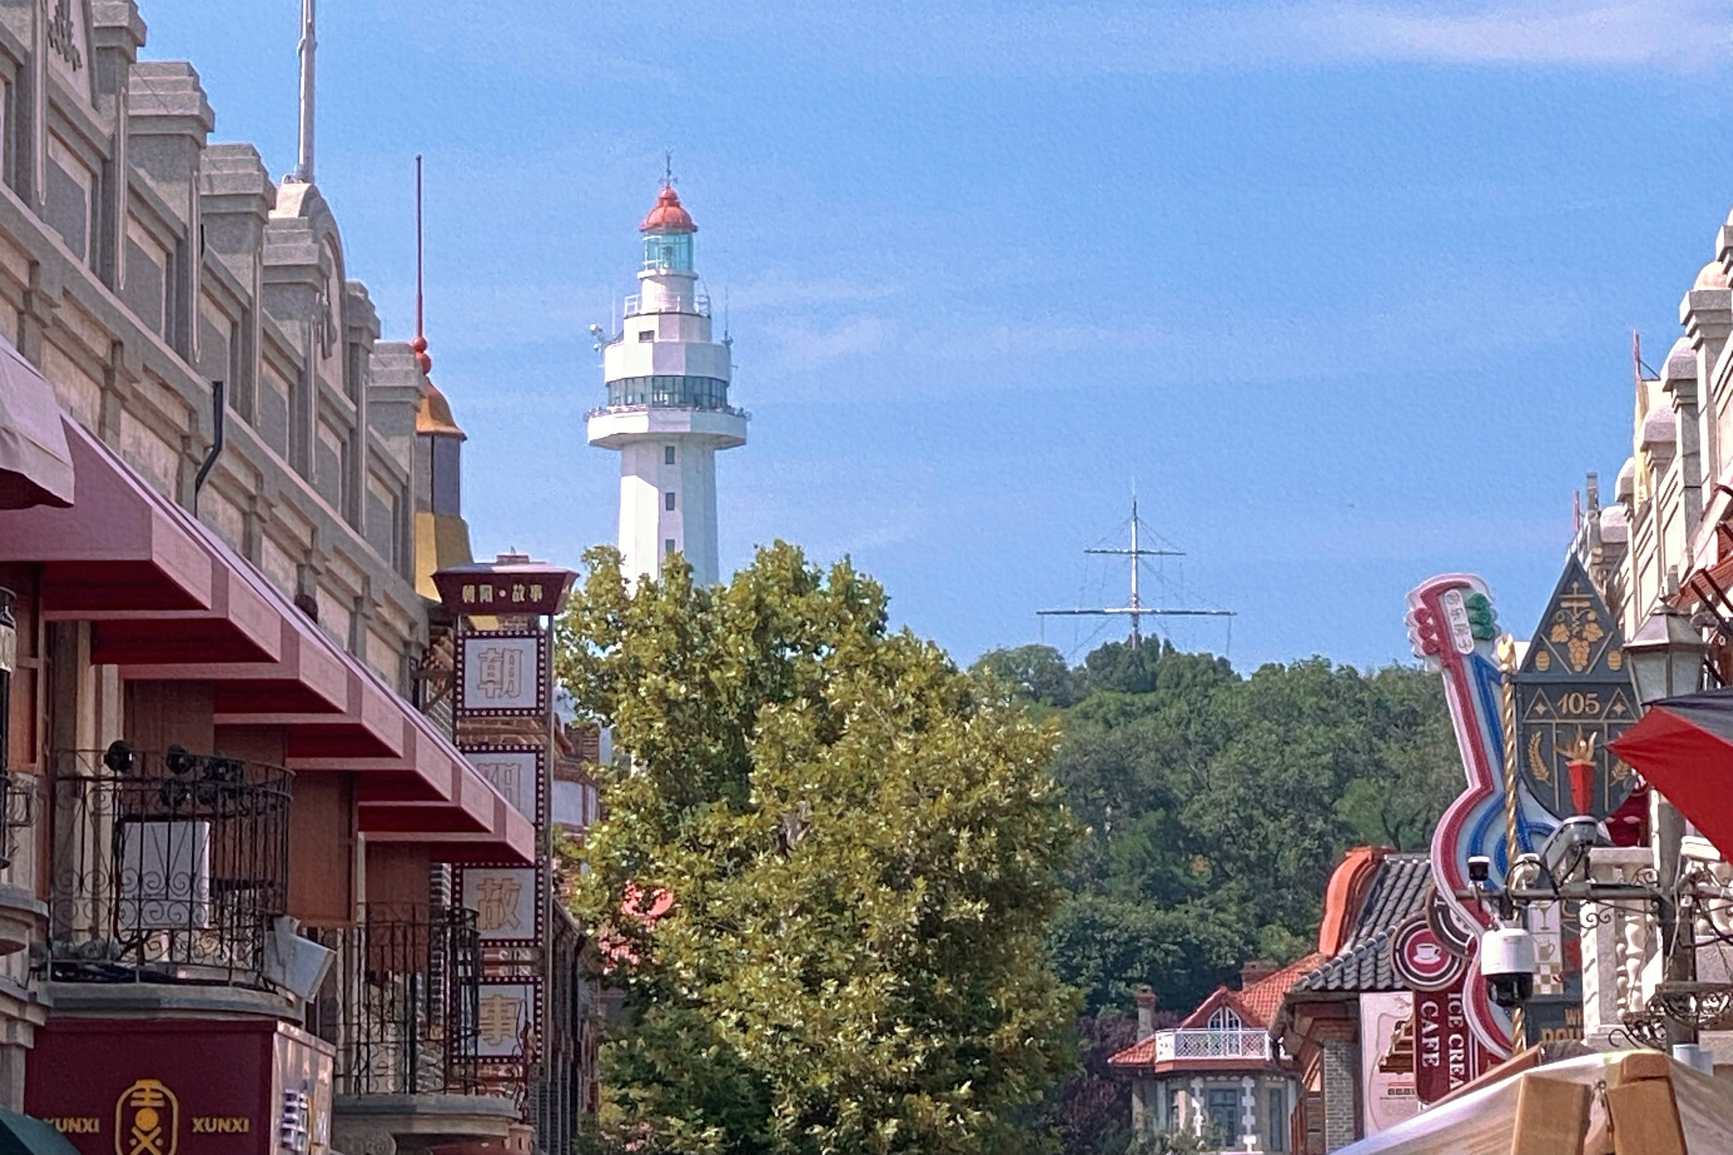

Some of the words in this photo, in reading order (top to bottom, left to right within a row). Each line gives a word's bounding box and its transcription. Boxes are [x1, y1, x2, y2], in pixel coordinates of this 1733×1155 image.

[1557, 692, 1601, 714] 105
[1447, 992, 1464, 1028] ICE
[1421, 1000, 1440, 1068] CAFE
[192, 1117, 250, 1133] XUNXI
